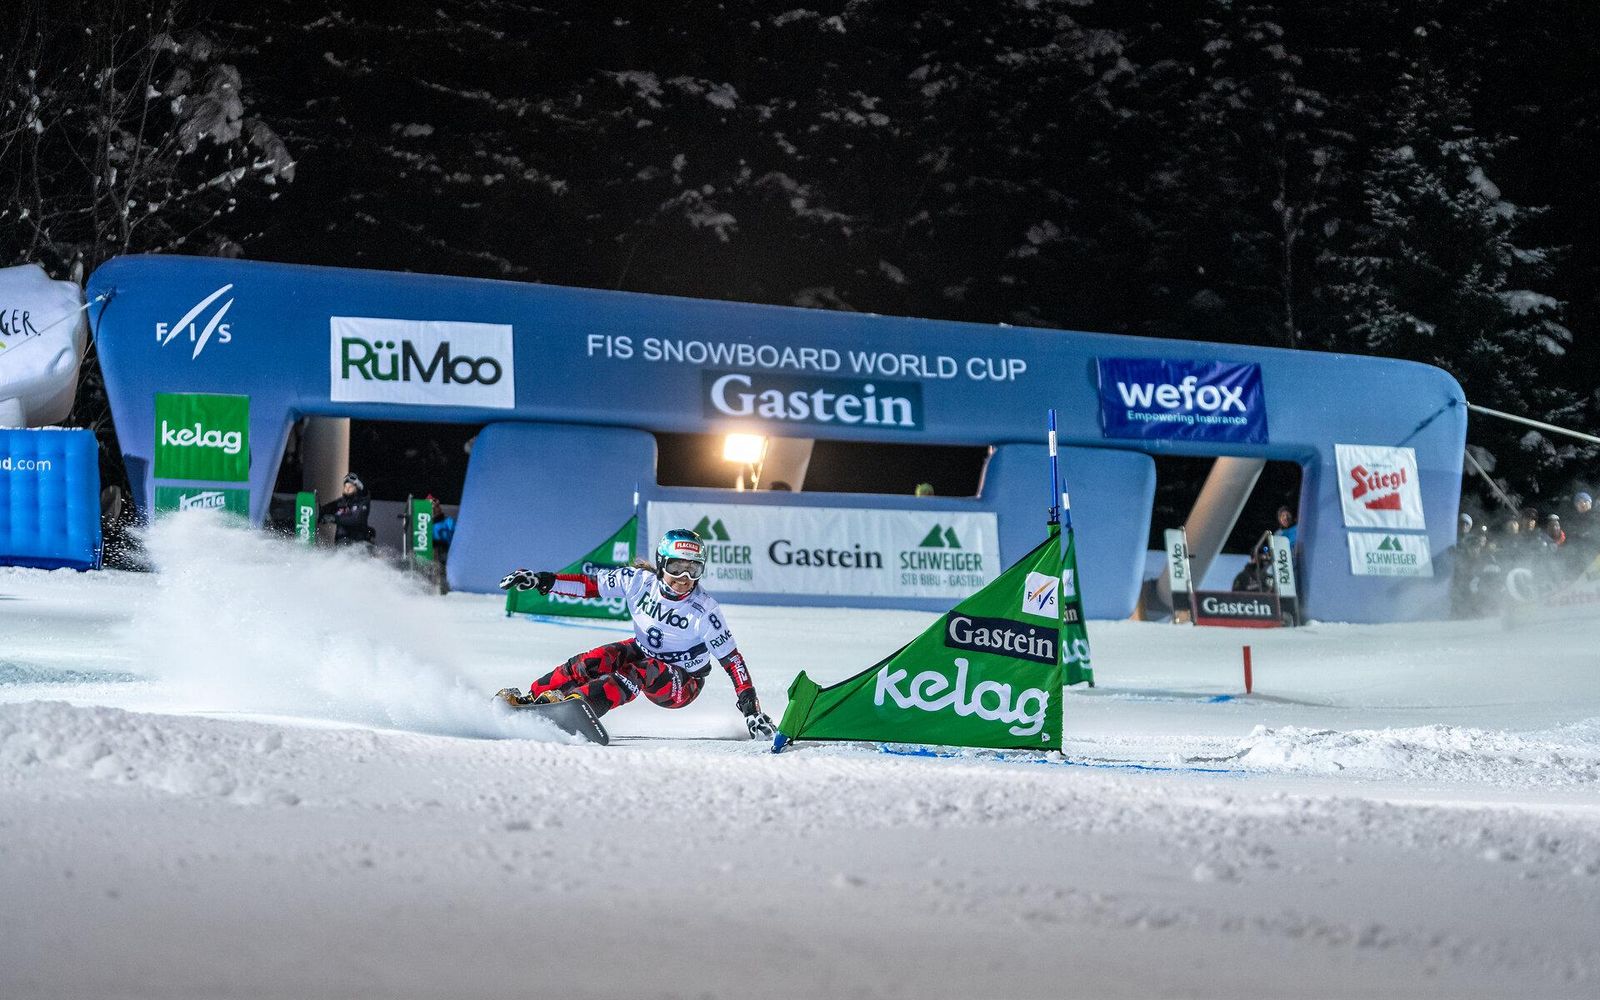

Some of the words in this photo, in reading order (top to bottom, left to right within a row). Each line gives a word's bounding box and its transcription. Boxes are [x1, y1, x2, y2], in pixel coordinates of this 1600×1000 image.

[156, 322, 232, 343] FIS
[341, 336, 502, 385] RüMoo
[587, 334, 634, 359] FIS
[643, 337, 842, 372] SNOWBOARD
[849, 350, 958, 379] WORLD
[966, 357, 1027, 381] CUP
[710, 374, 915, 427] Gastein
[1117, 375, 1247, 412] wefox
[1127, 410, 1194, 426] Empowering
[1195, 414, 1248, 426] Insurance
[161, 420, 242, 454] kelag
[0, 457, 51, 471] d.com
[1350, 464, 1407, 500] Stiegl
[296, 505, 313, 543] elag
[414, 513, 431, 550] kelag
[706, 545, 752, 564] EIGER
[768, 539, 884, 569] Gastein
[900, 551, 983, 571] SCHWEIGER
[1366, 552, 1418, 565] SCHWEIGER
[1028, 591, 1055, 604] FIS
[1203, 597, 1272, 615] Gastein
[709, 613, 722, 630] 8
[647, 626, 663, 649] 8
[949, 616, 1054, 659] Gastein
[874, 657, 1050, 736] kelag
